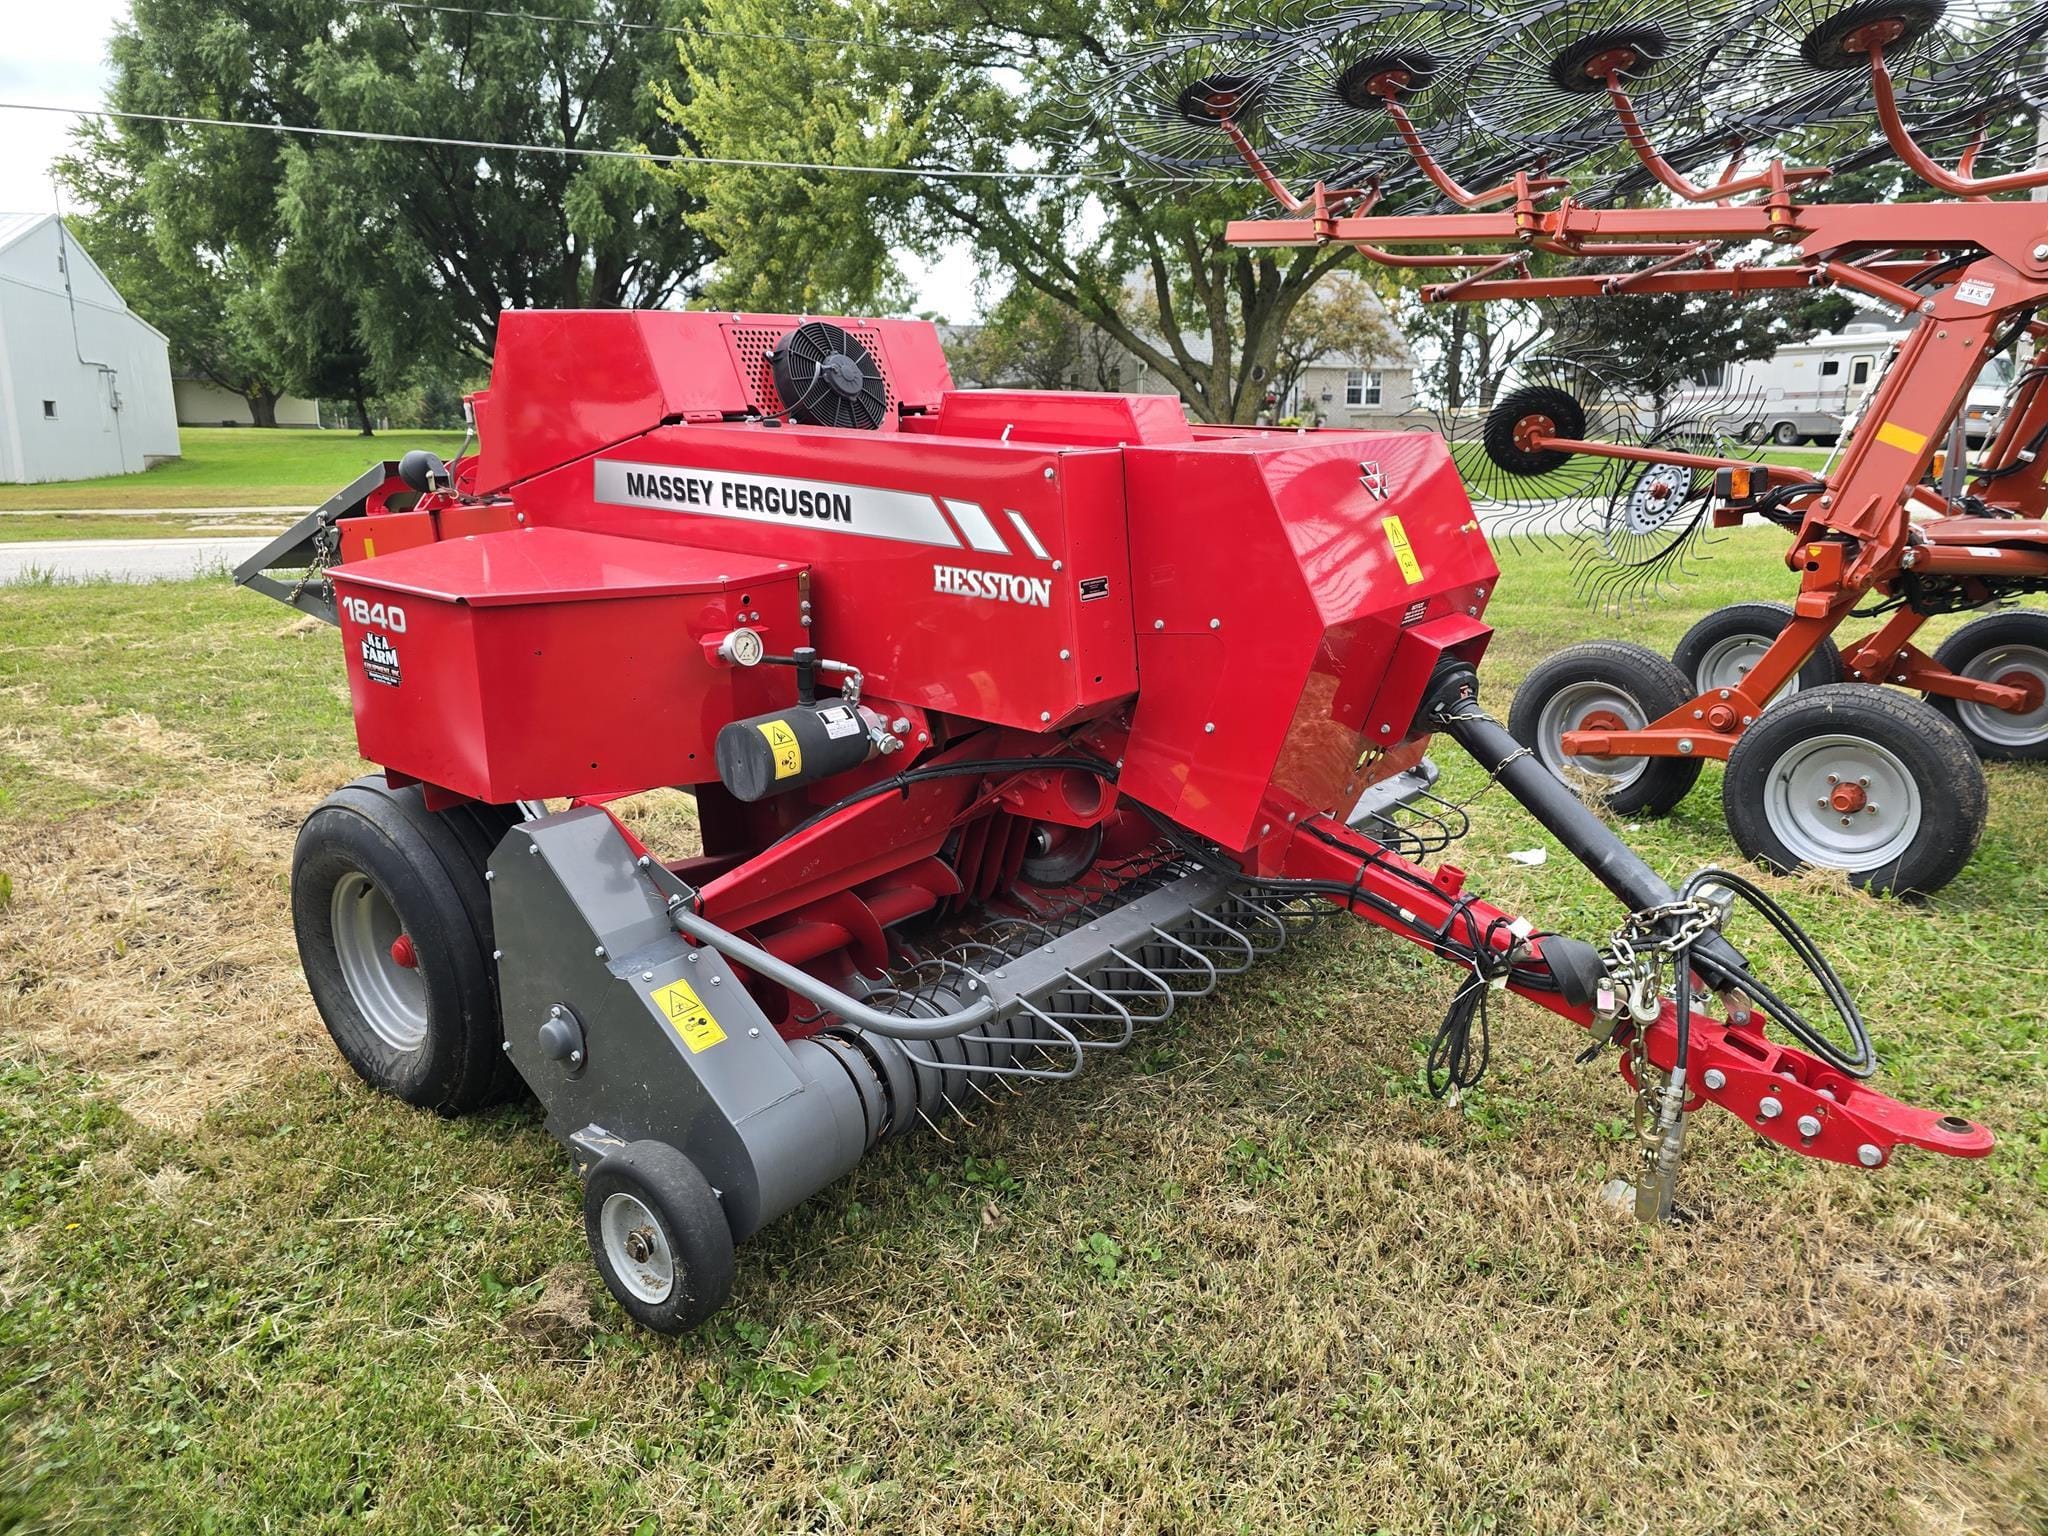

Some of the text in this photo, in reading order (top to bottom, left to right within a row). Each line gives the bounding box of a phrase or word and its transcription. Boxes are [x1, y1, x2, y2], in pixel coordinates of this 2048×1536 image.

[626, 472, 852, 523] MASSEY FERGUSON
[933, 565, 1052, 608] HESSTON
[342, 596, 407, 633] 1840
[361, 641, 399, 667] FARM
